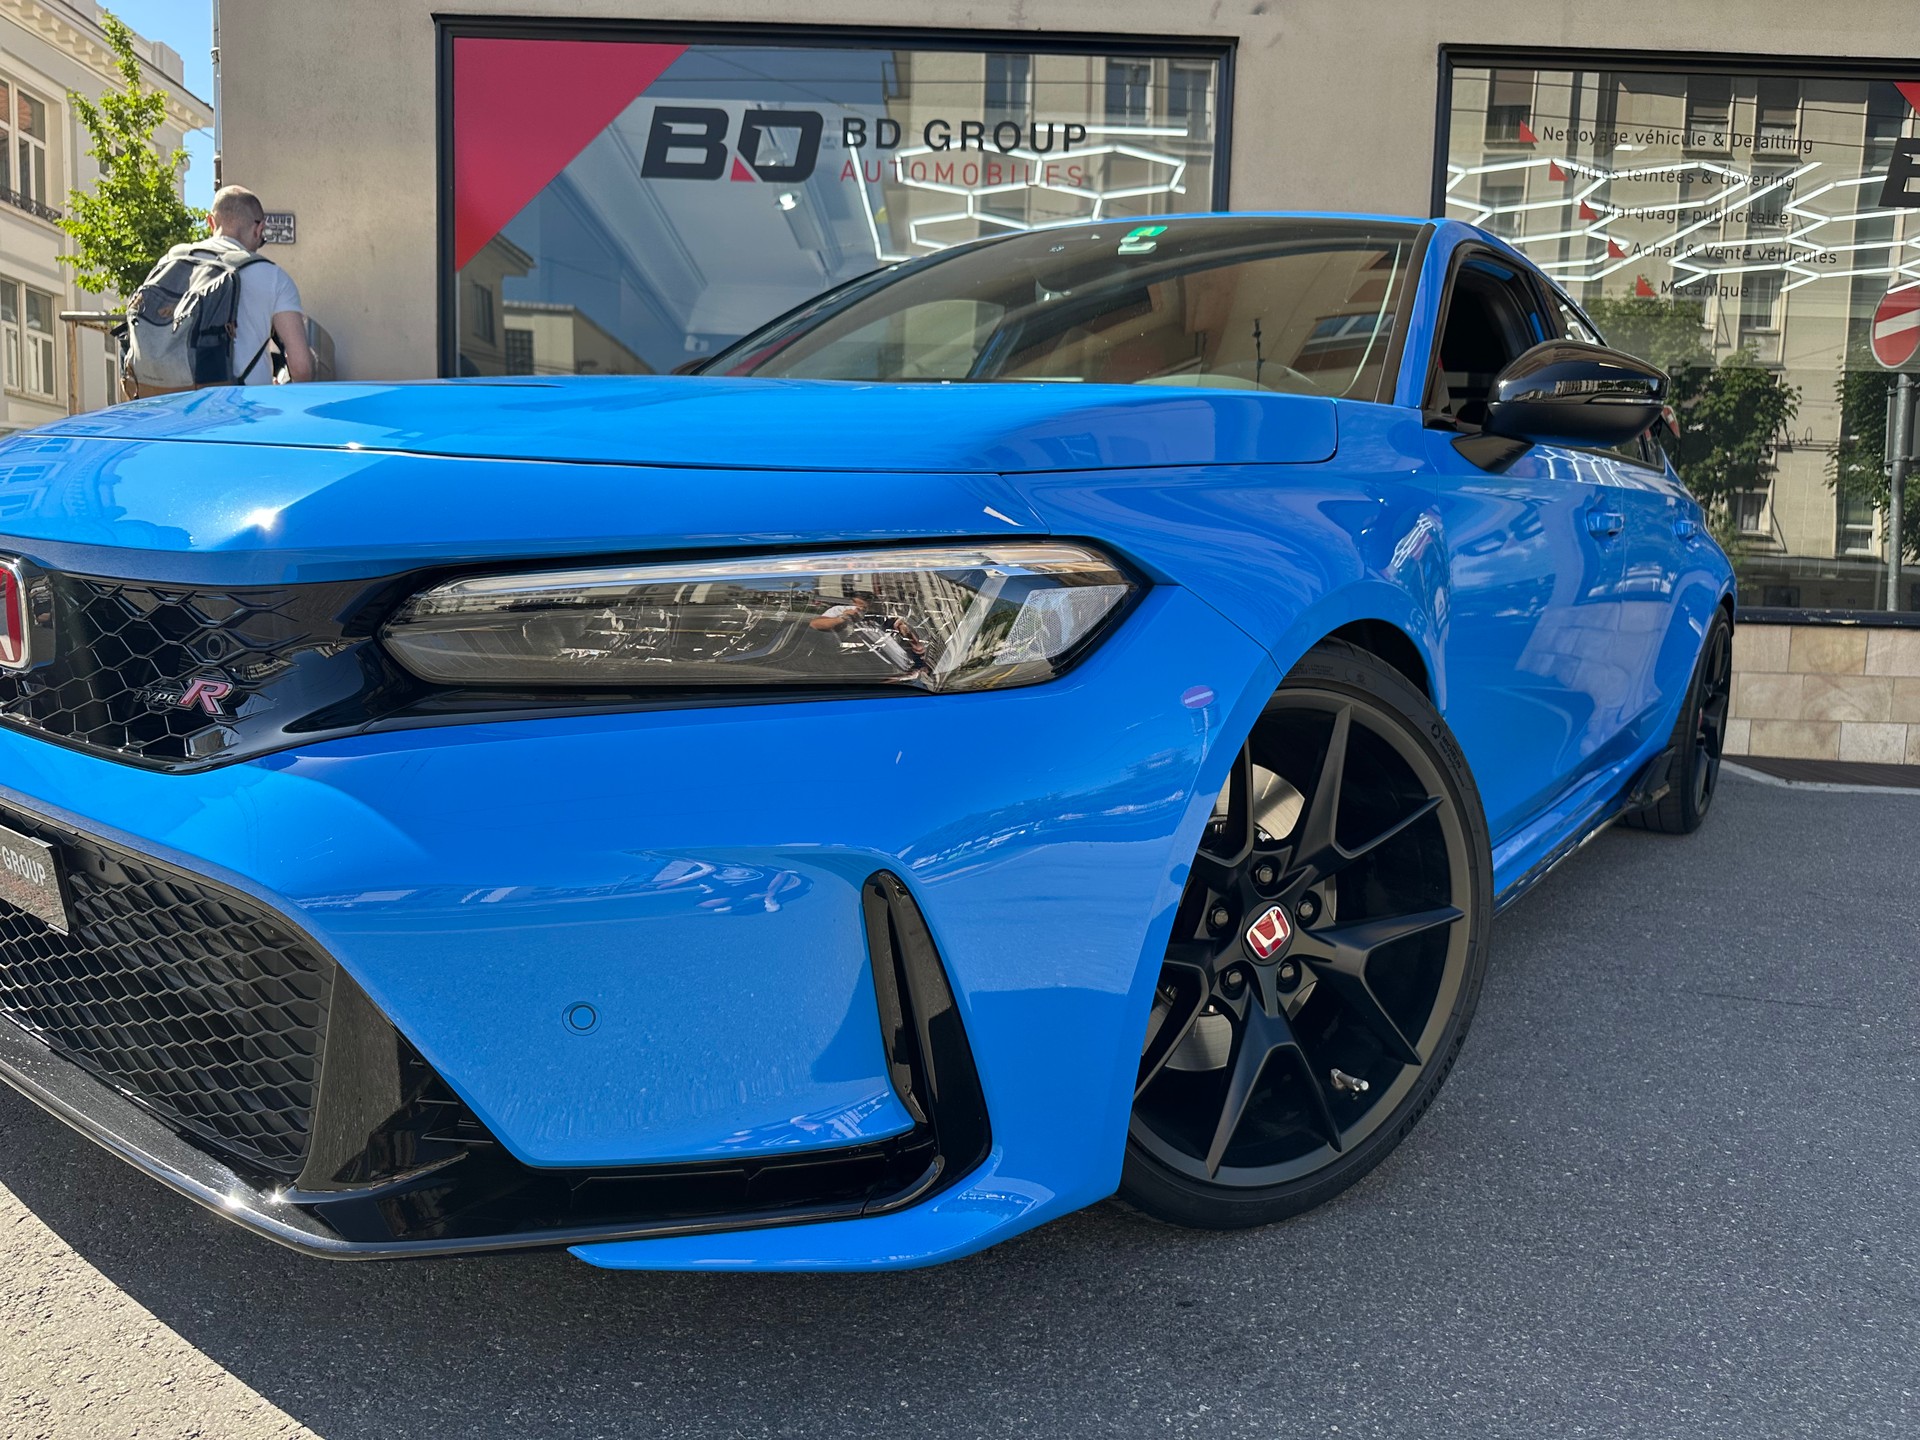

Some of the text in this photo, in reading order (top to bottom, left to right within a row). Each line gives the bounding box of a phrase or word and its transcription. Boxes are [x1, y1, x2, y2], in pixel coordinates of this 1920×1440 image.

[641, 106, 824, 183] BD
[842, 117, 1087, 153] BD GROUP
[1543, 126, 1813, 154] Nettoyage véhicule & Detailling
[840, 159, 1083, 188] AUTOMOBILES
[1570, 165, 1795, 191] Vitres teintées & Covering
[1603, 203, 1789, 225] Marquage publicitaire
[1631, 242, 1837, 265] Achat & Vente véhicules
[179, 678, 235, 718] R
[1, 845, 47, 887] GROUP
